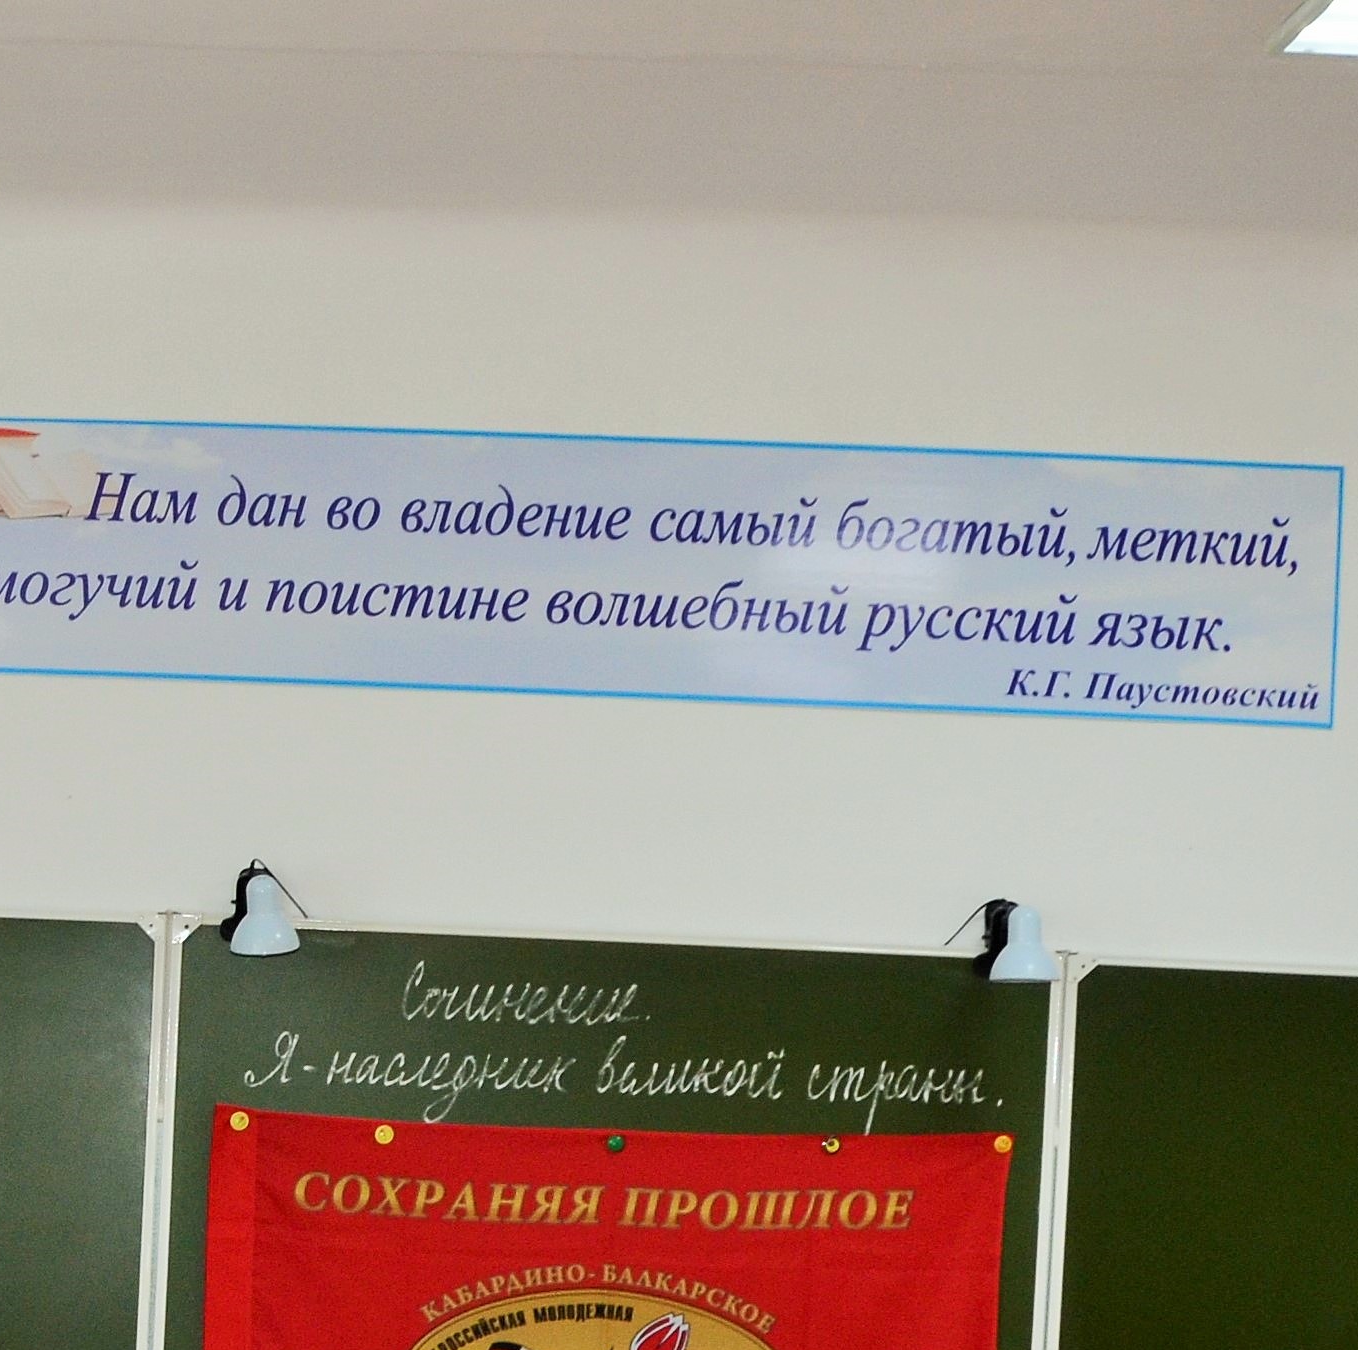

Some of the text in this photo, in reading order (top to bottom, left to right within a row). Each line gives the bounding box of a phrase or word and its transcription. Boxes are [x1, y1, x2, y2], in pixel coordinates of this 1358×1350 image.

[85, 471, 1301, 576] Нам дан во владение самый богатый, меткий,
[219, 572, 247, 611] и
[266, 575, 529, 624] поистине
[545, 580, 848, 638] волшебный
[855, 594, 1079, 653] русский
[1088, 611, 1233, 654] язык.
[1006, 667, 1320, 712] К.Г. Паустовский
[596, 1034, 786, 1100] великой
[292, 1171, 916, 1235] СОХРАНЯЯ ПРОШЛОЕ
[533, 1302, 635, 1323] МОЛОДЕЖНАЯ
